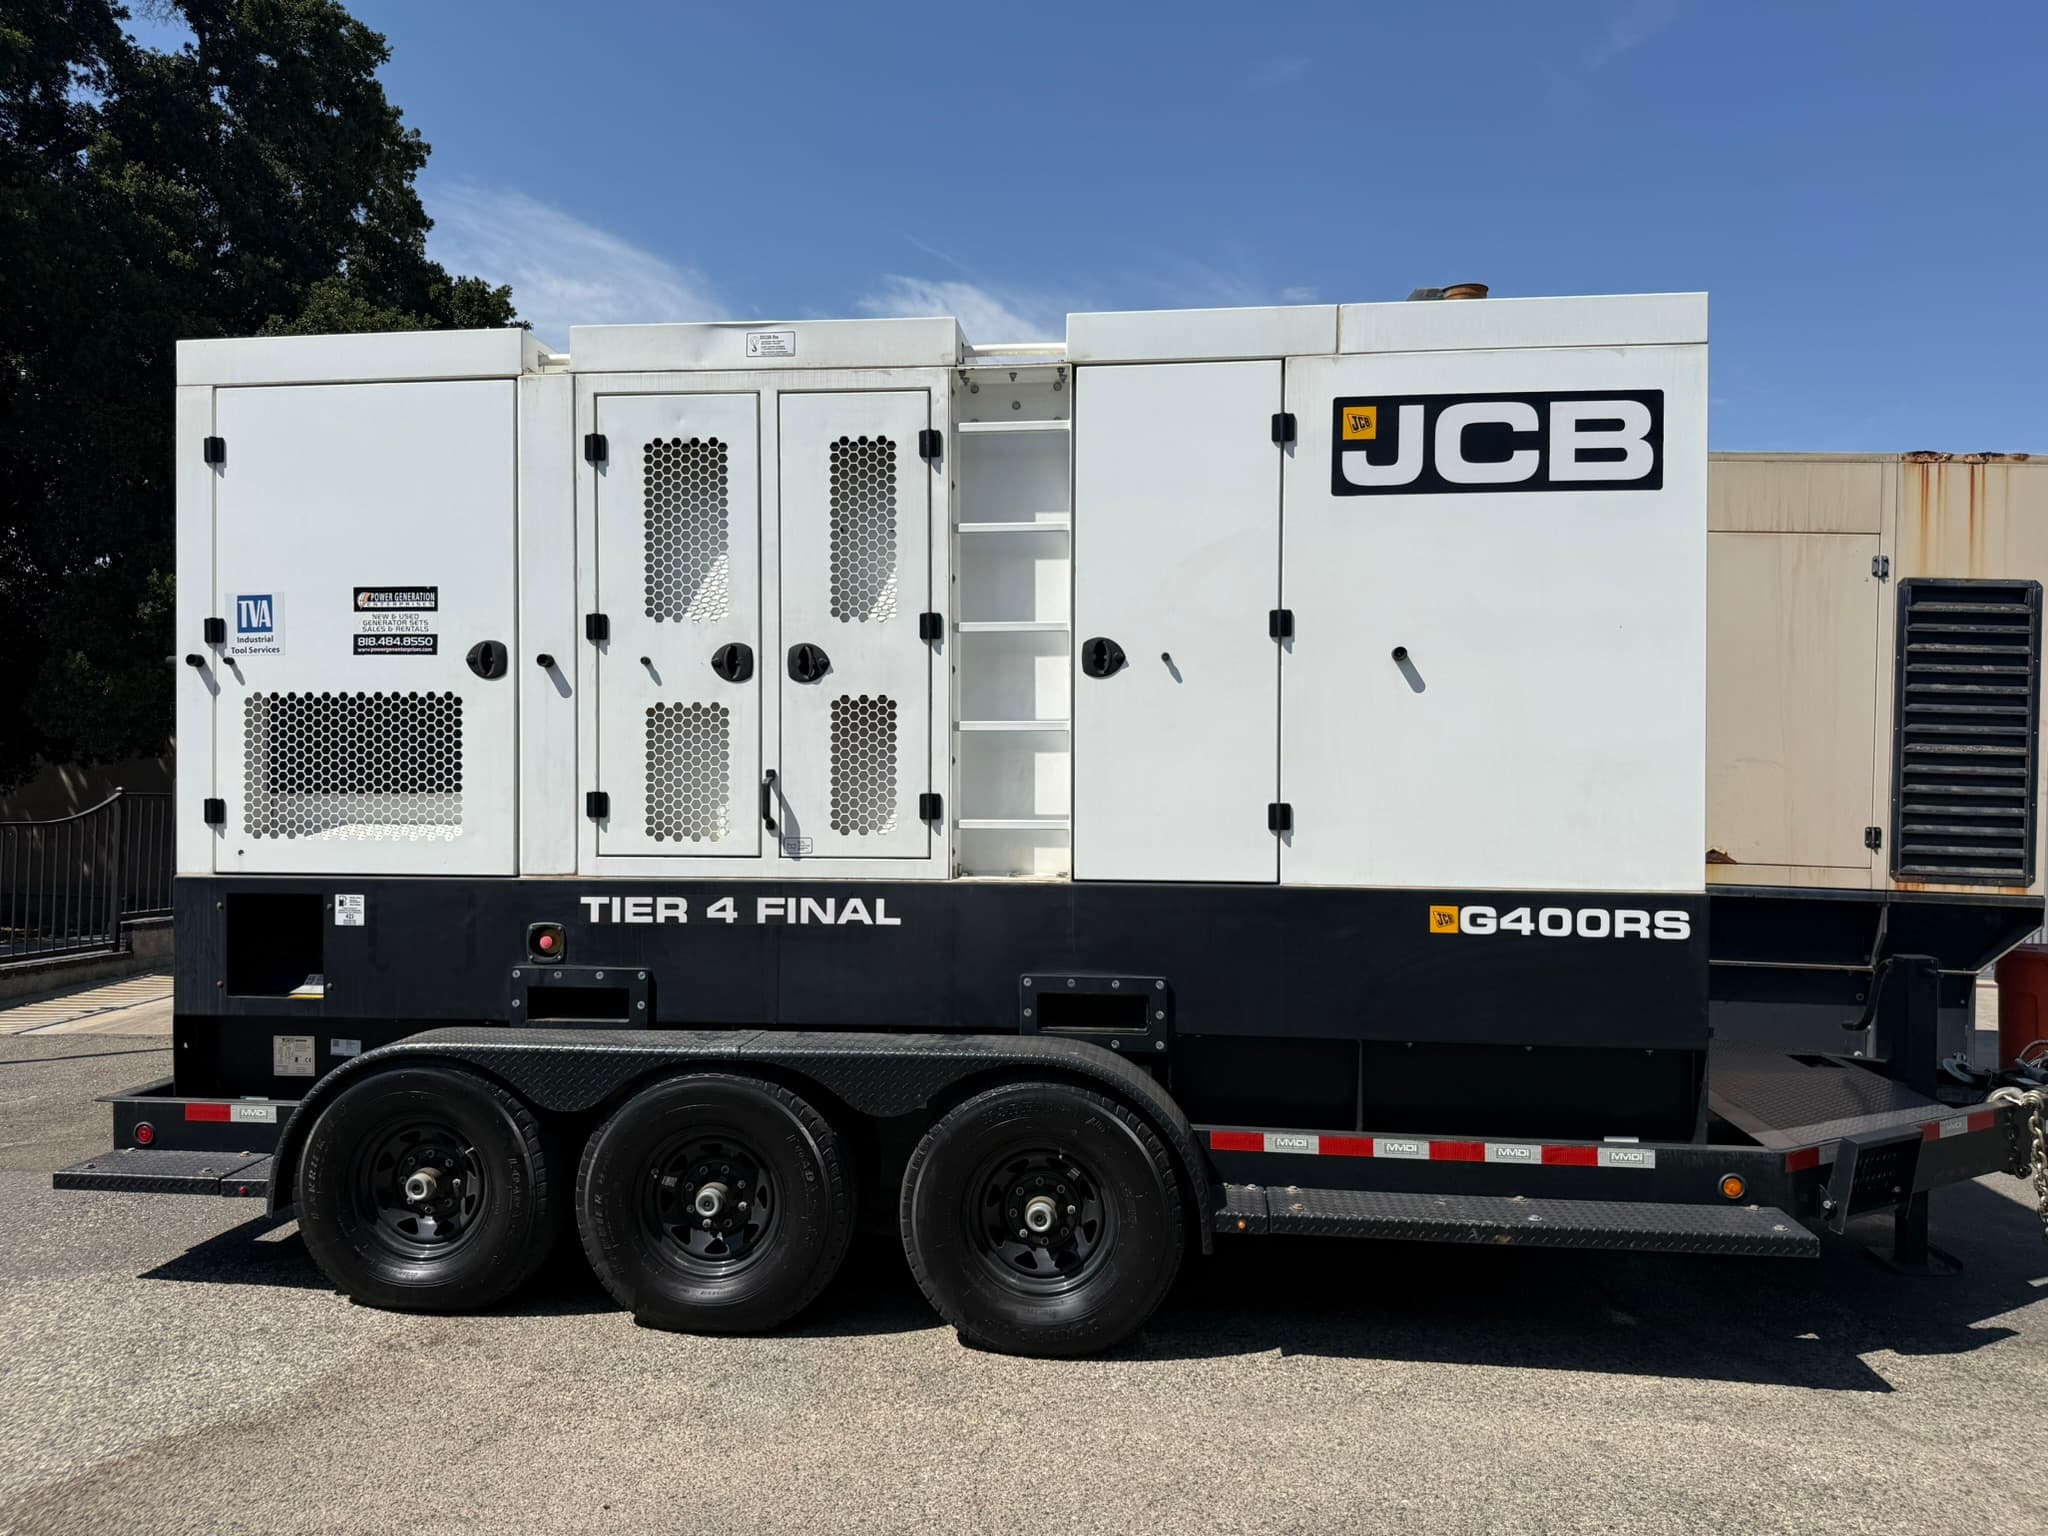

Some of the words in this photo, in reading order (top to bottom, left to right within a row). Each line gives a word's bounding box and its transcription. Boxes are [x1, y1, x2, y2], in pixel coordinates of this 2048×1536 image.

[1351, 415, 1371, 431] JCB
[1341, 400, 1654, 487] JCB
[371, 592, 393, 601] POWER
[394, 591, 435, 601] GENERATION
[238, 599, 272, 628] TVA
[395, 625, 429, 633] RENTALS
[237, 635, 274, 644] Industrial
[357, 636, 433, 647] 818.484.8550
[231, 646, 248, 654] Tool
[248, 645, 280, 654] Services
[579, 896, 688, 925] TIER
[706, 896, 739, 925] 4
[756, 897, 902, 926] FINAL
[1459, 905, 1691, 941] G400RS
[1276, 1138, 1307, 1147] MMDI
[1386, 1143, 1417, 1152] MMDI
[1498, 1148, 1530, 1157] MMDI
[1611, 1152, 1643, 1161] MMDI
